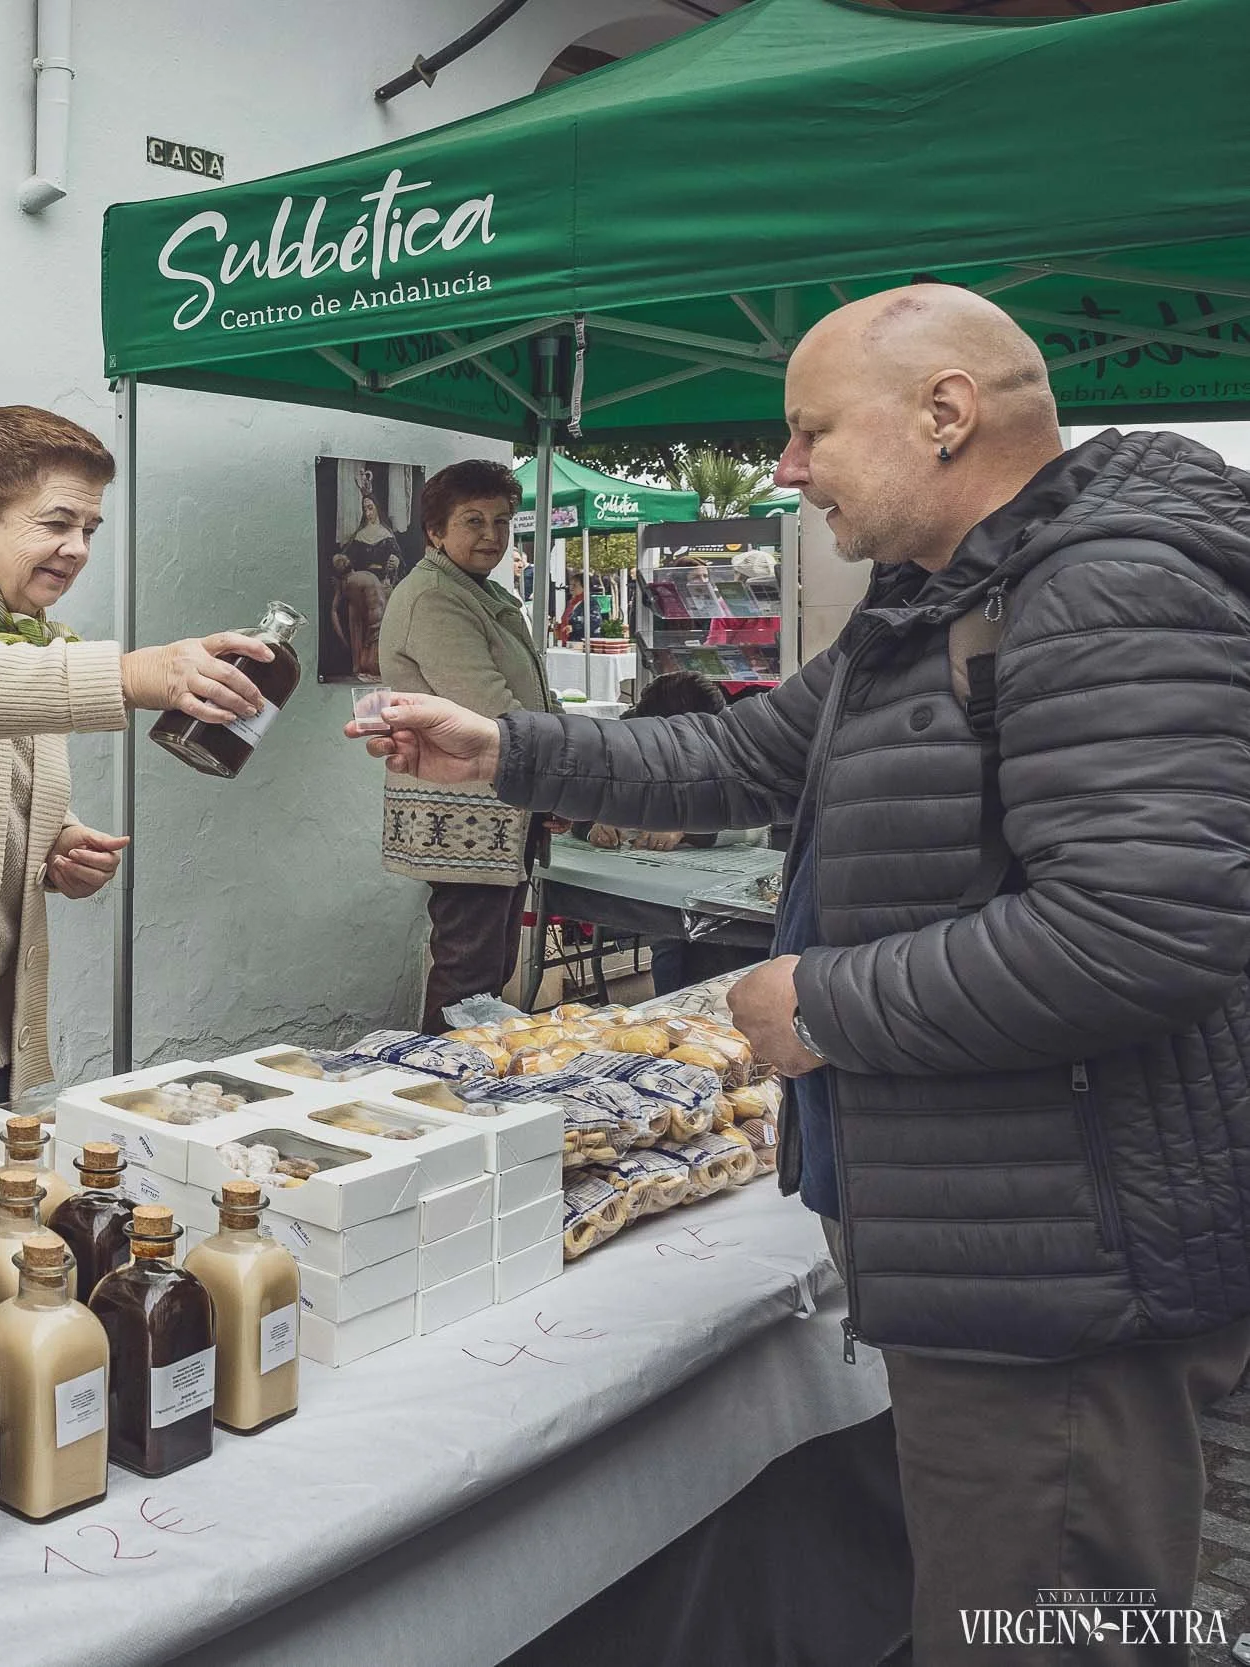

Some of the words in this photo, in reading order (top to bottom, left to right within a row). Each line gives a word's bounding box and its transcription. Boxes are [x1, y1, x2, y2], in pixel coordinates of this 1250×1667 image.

[149, 140, 223, 177] CASA
[158, 168, 496, 331] Subbética
[220, 303, 303, 331] Centro
[310, 294, 342, 317] de
[349, 269, 493, 312] Andalucía
